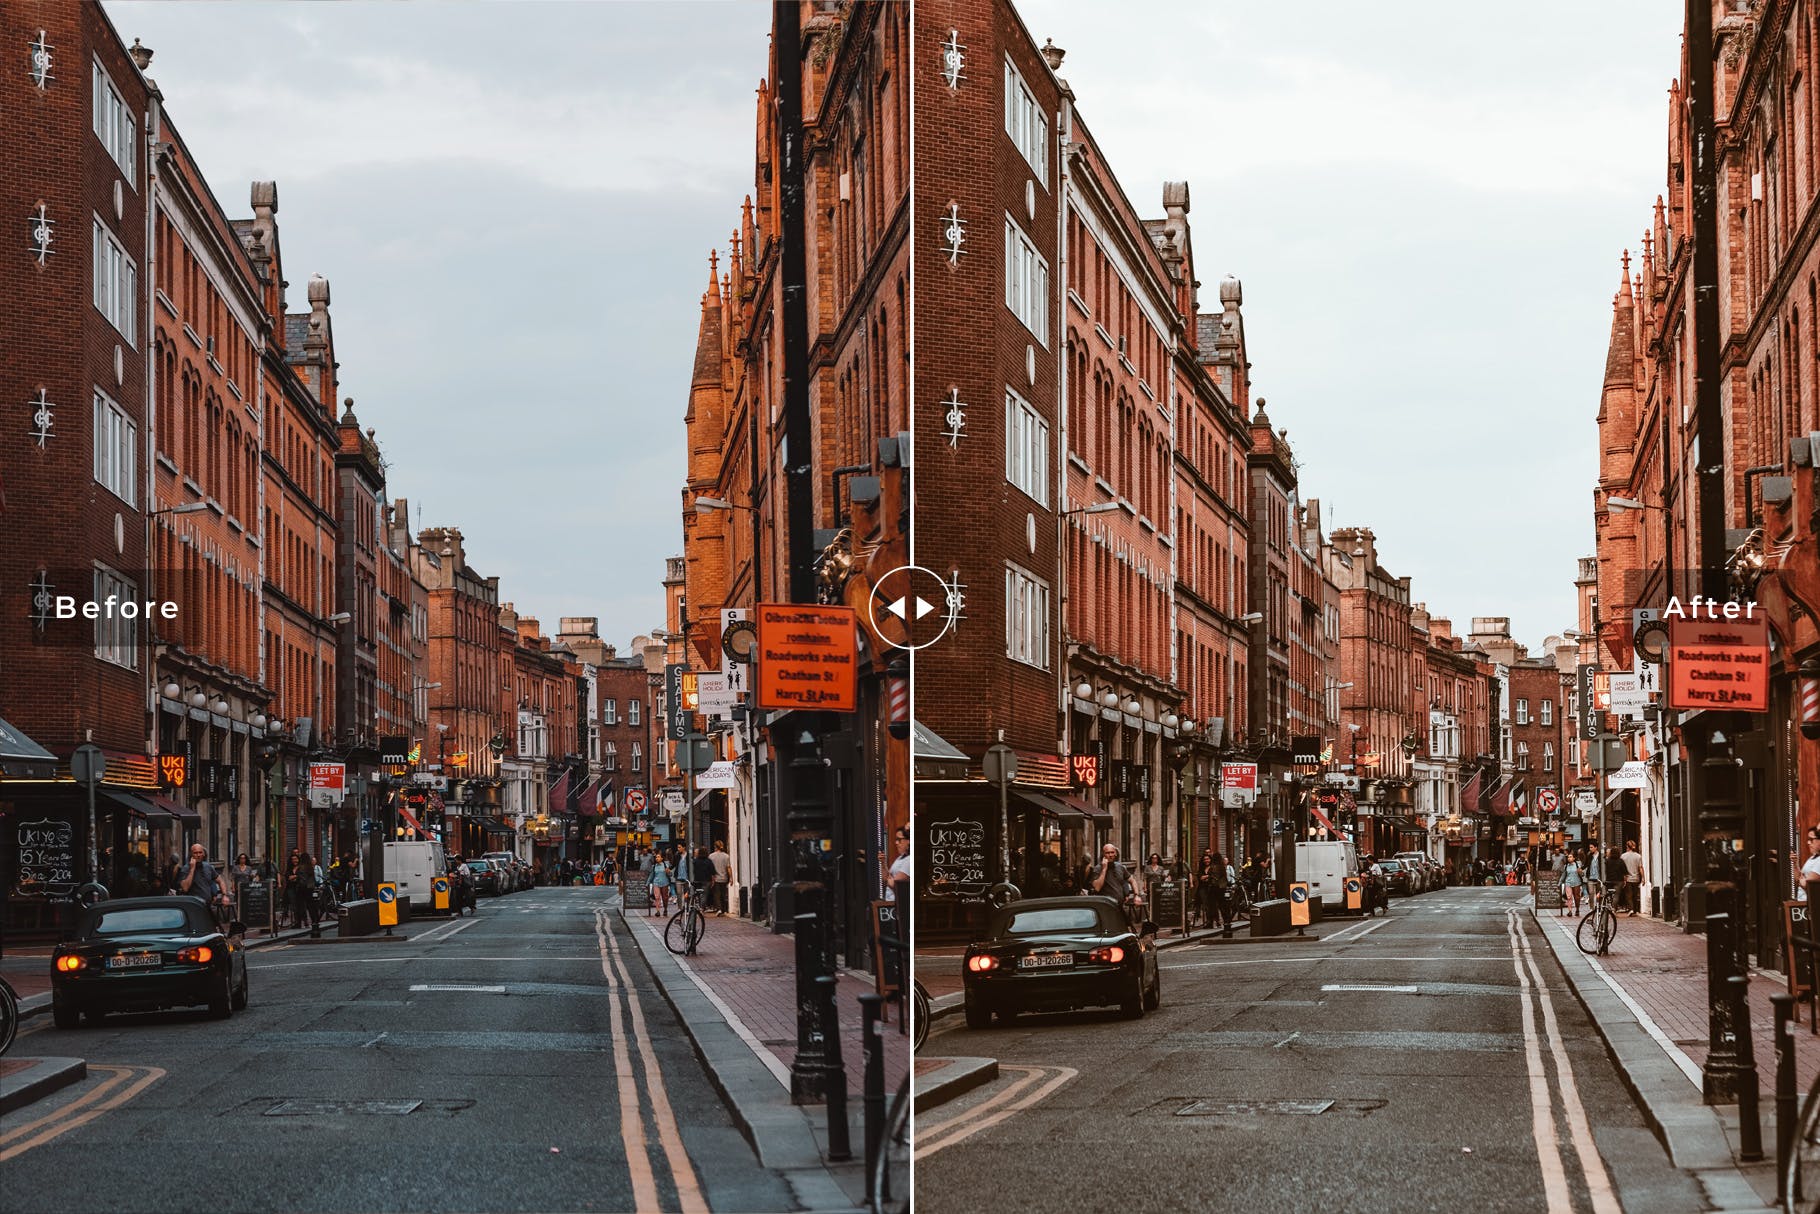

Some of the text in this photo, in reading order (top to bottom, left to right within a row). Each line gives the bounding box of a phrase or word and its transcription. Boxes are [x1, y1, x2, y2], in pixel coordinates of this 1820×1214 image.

[766, 649, 850, 664] Roadworks ahead
[1678, 649, 1762, 664] Roadworks ahead
[778, 669, 820, 681] Chatham
[823, 671, 833, 682] St
[1690, 669, 1732, 681] Chatham
[1735, 671, 1745, 682] St
[776, 688, 840, 702] Harry St Area
[1688, 688, 1752, 702] Harry St Area
[161, 755, 185, 768] UKI
[1073, 755, 1097, 768] UKI
[315, 767, 340, 775] LET BY
[1227, 767, 1252, 775] LET BY
[20, 849, 33, 865] 15
[932, 849, 945, 865] 15
[49, 868, 72, 883] 2004
[961, 868, 984, 883] 2004
